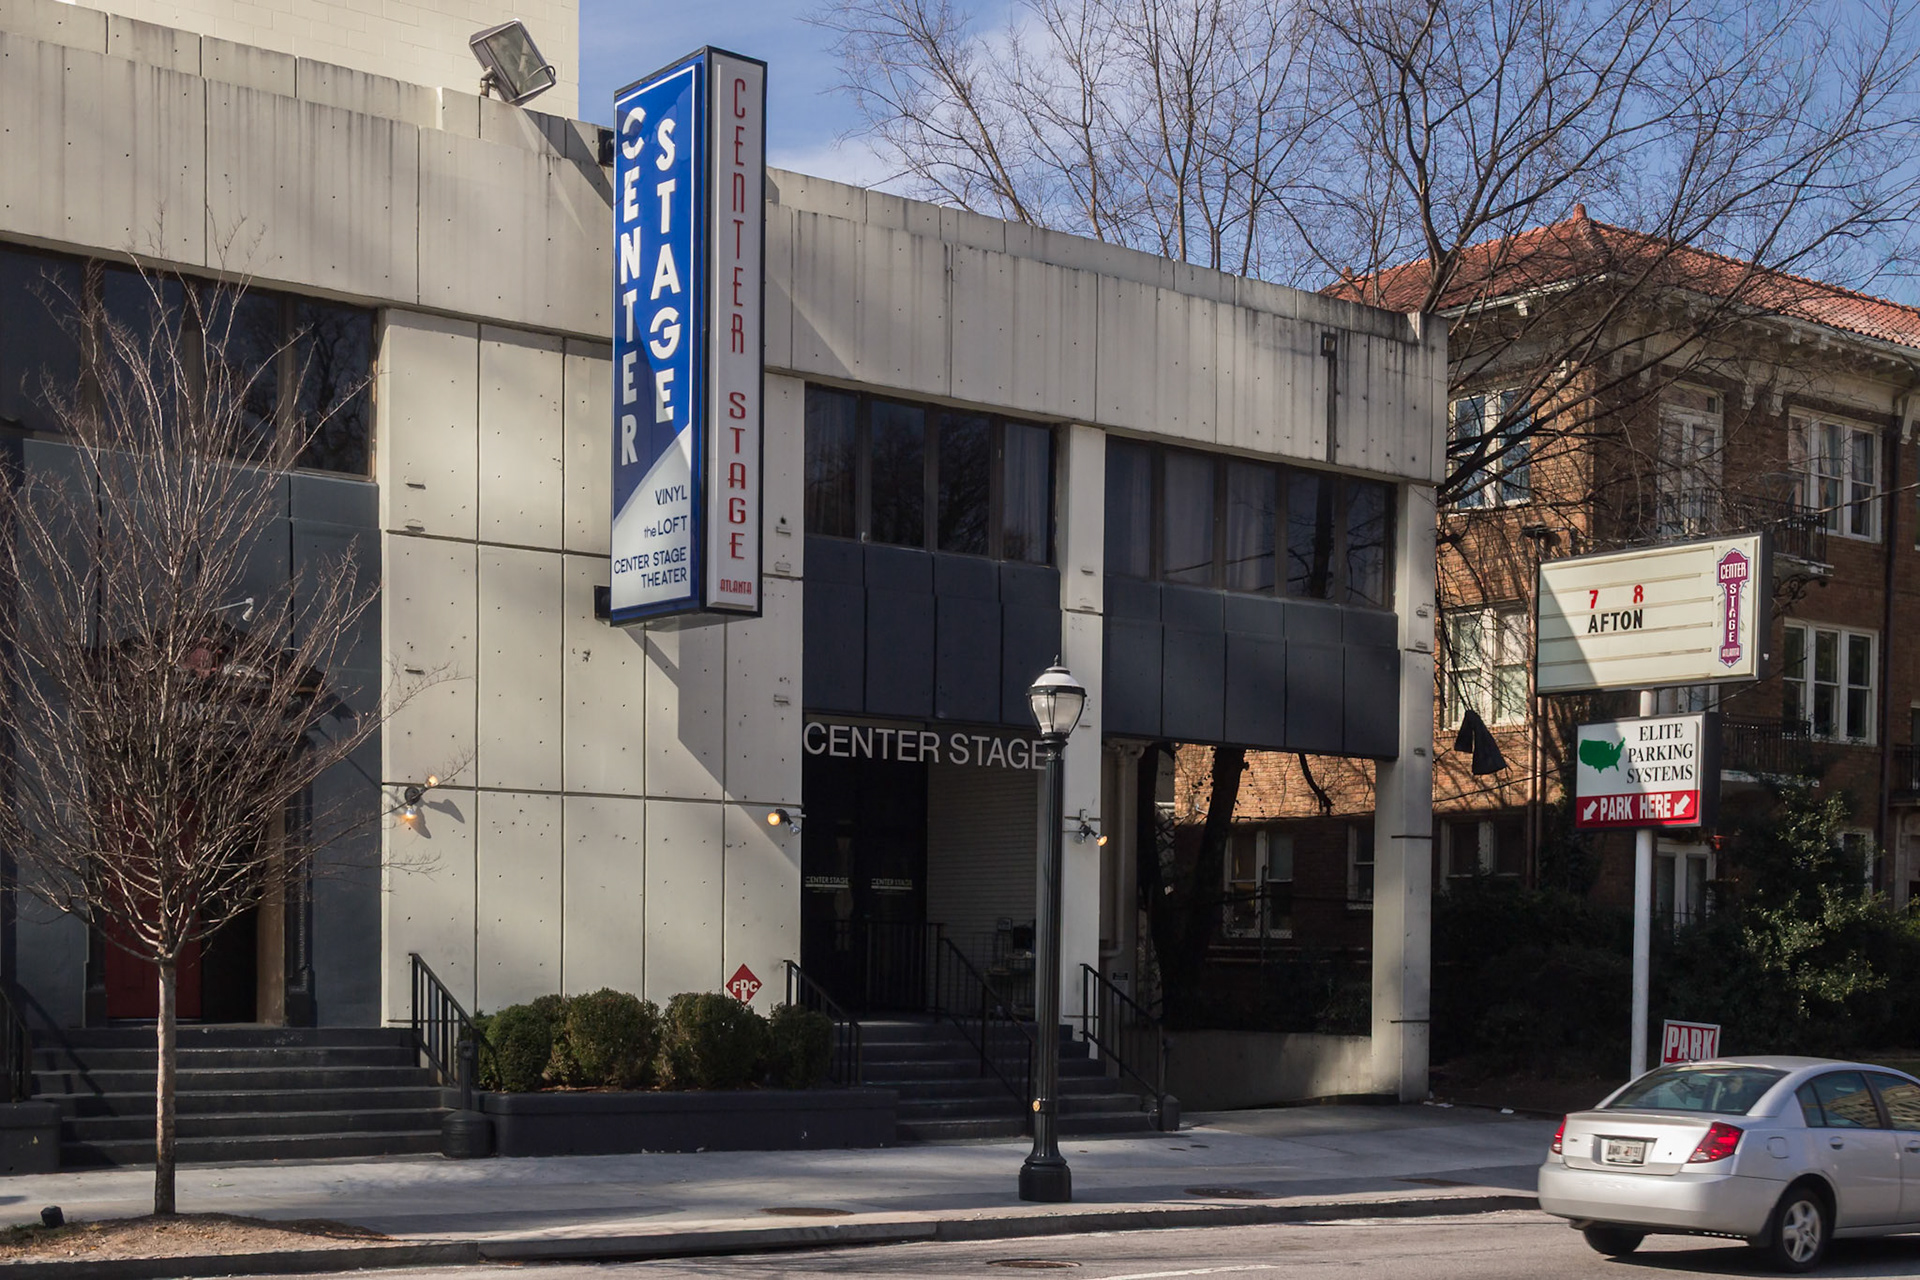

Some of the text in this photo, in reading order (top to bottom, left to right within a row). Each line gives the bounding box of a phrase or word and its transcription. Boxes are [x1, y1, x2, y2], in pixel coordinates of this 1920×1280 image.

[650, 118, 681, 424] STAGE
[618, 106, 647, 467] CENTER
[728, 78, 746, 560] CENTER STAGE
[655, 484, 688, 506] VINYL
[644, 515, 688, 539] the LOFT
[613, 546, 687, 575] CENTER STAGE
[1720, 562, 1747, 580] CENTER
[641, 566, 687, 589] THEATER
[720, 578, 752, 594] ATLANTA
[1588, 584, 1644, 609] 7 8
[1587, 608, 1643, 634] AFTON
[1728, 583, 1737, 642] STAGE
[1639, 723, 1683, 742] ELITE
[803, 722, 1048, 771] CENTER STAGE
[1628, 743, 1693, 763] PARKING
[1626, 764, 1693, 784] SYSTEMS
[1600, 793, 1672, 821] PARK HERE
[732, 979, 758, 993] FDC
[1666, 1027, 1714, 1060] PARK
